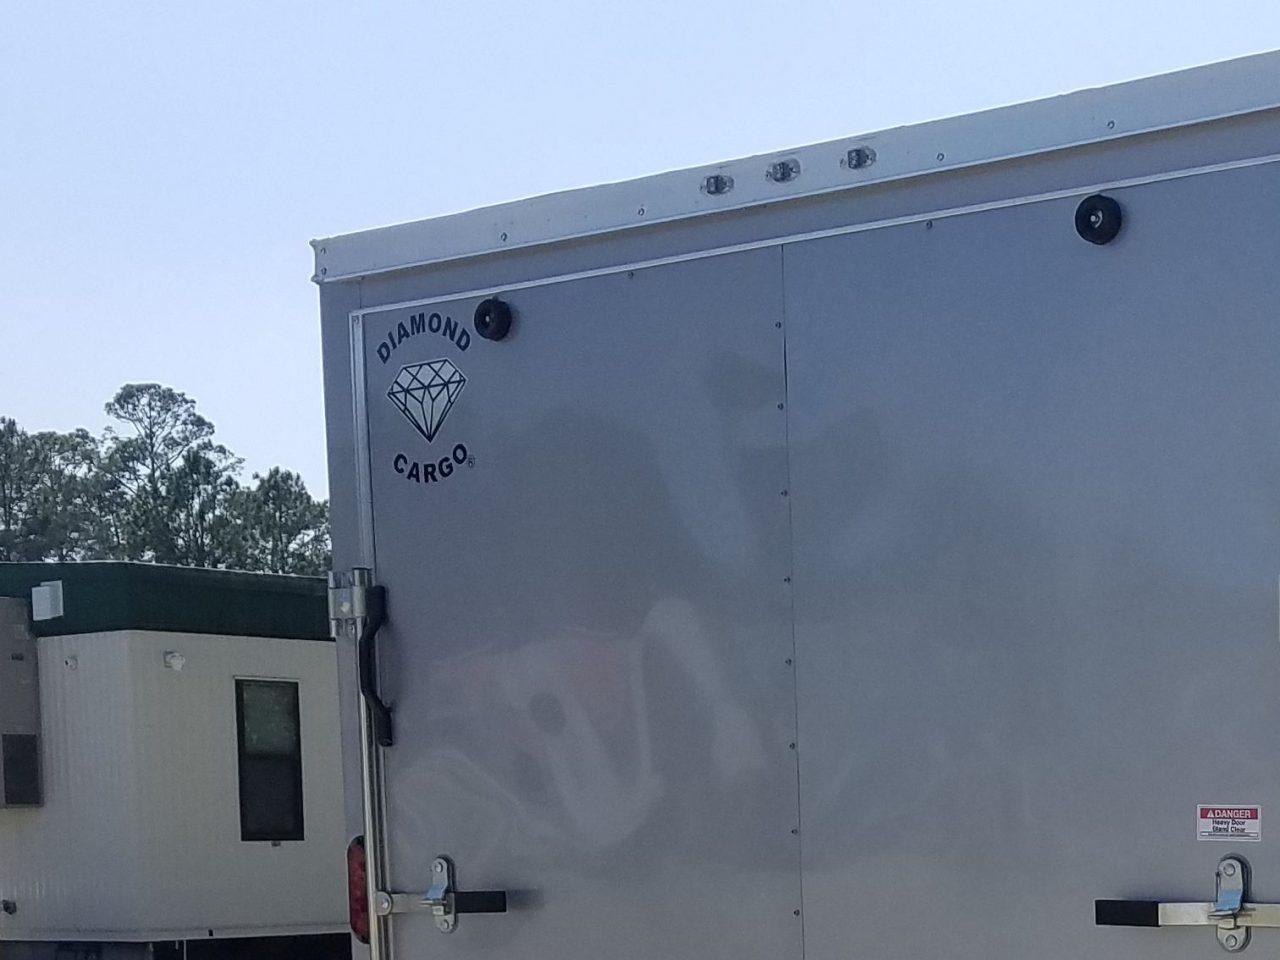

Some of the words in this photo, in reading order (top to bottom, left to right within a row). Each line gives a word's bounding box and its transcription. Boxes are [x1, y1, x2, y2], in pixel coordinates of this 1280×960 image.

[377, 312, 471, 364] DIAMOND
[393, 443, 467, 483] CARGO
[1214, 809, 1251, 818] DANGER
